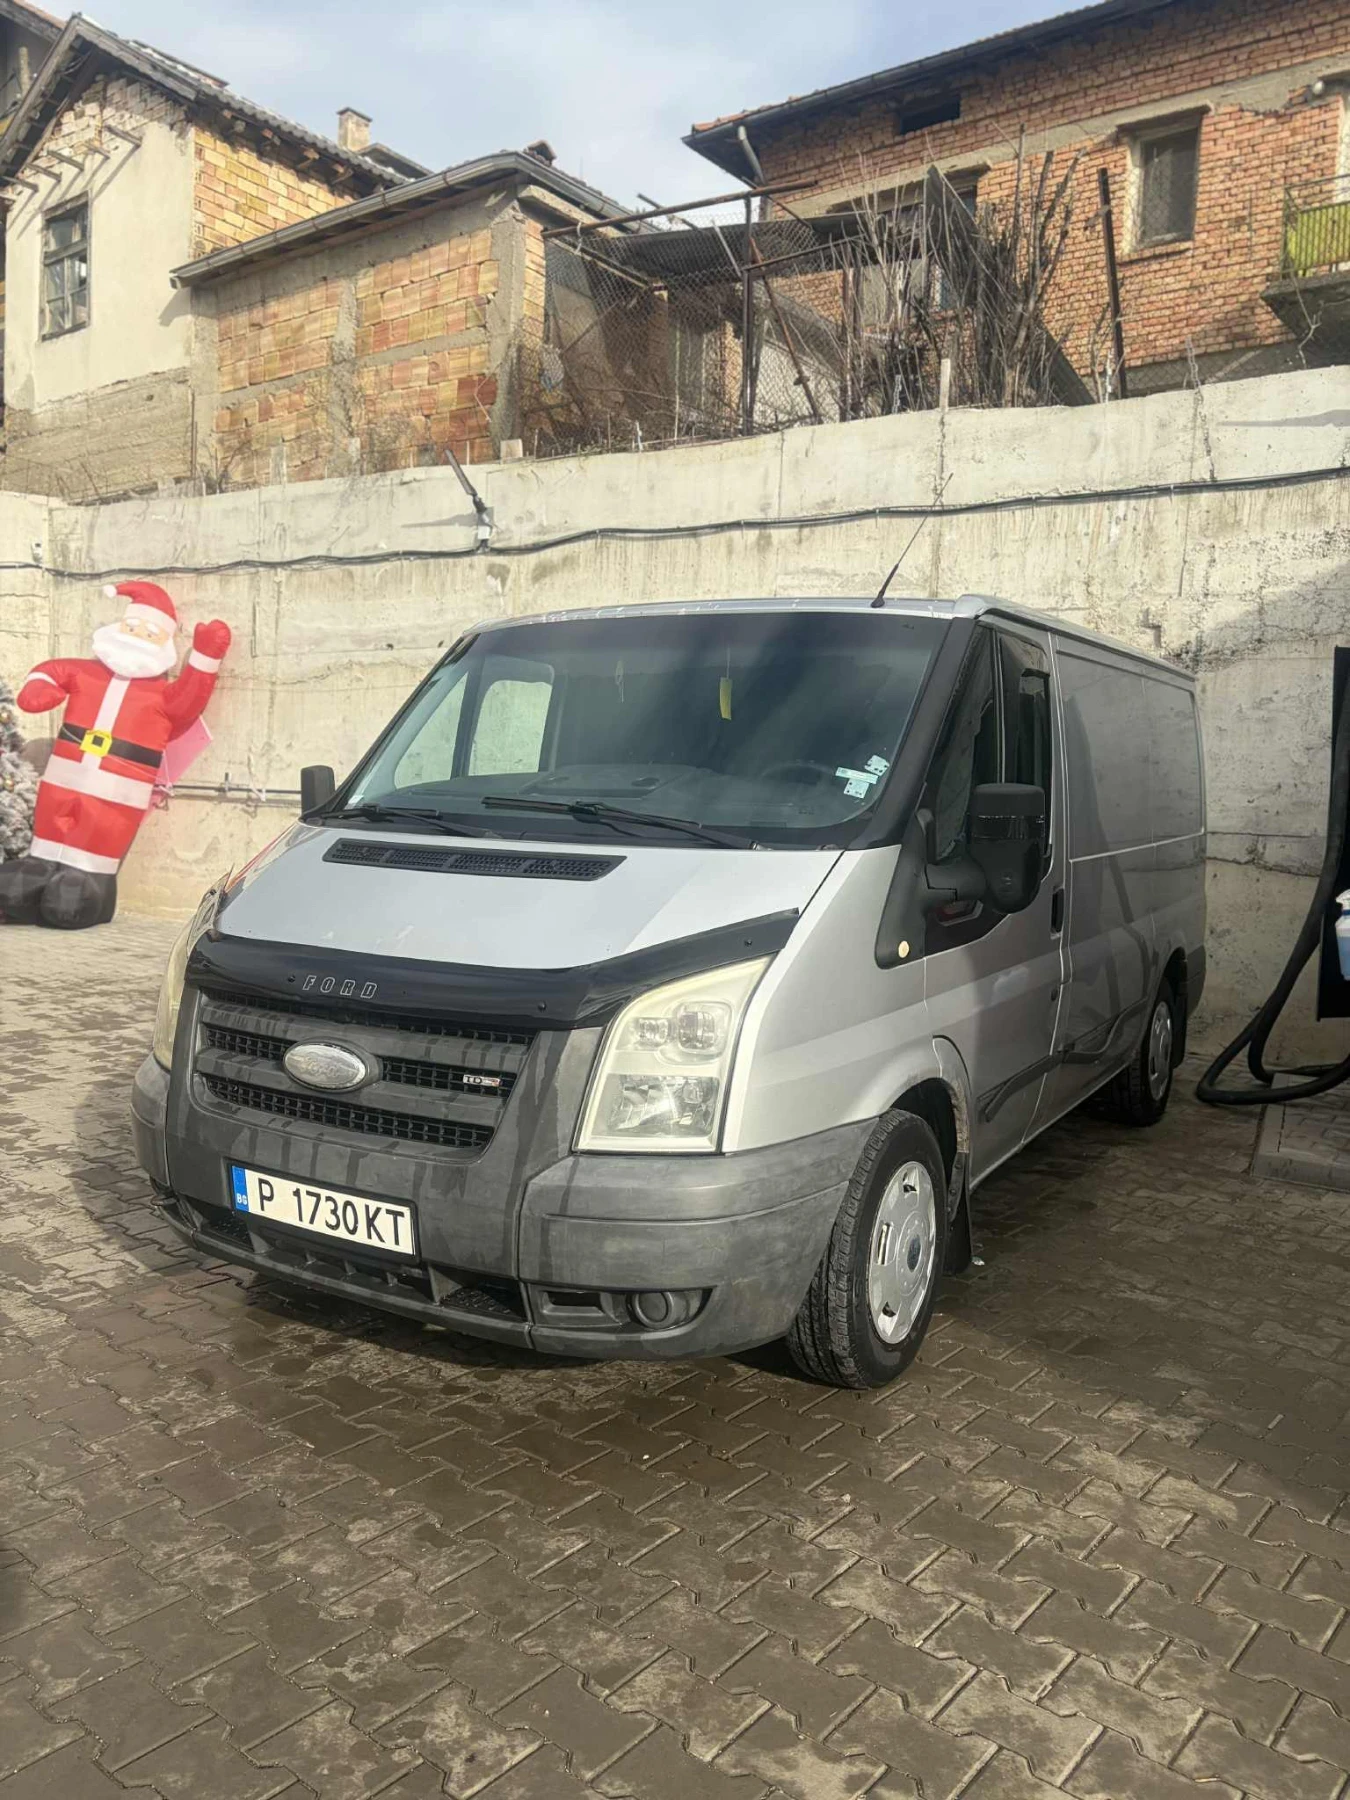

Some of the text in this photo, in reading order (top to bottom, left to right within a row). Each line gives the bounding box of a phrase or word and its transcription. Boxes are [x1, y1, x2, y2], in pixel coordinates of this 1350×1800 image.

[302, 974, 378, 999] FORD
[236, 1193, 248, 1206] BG
[257, 1177, 275, 1212] P
